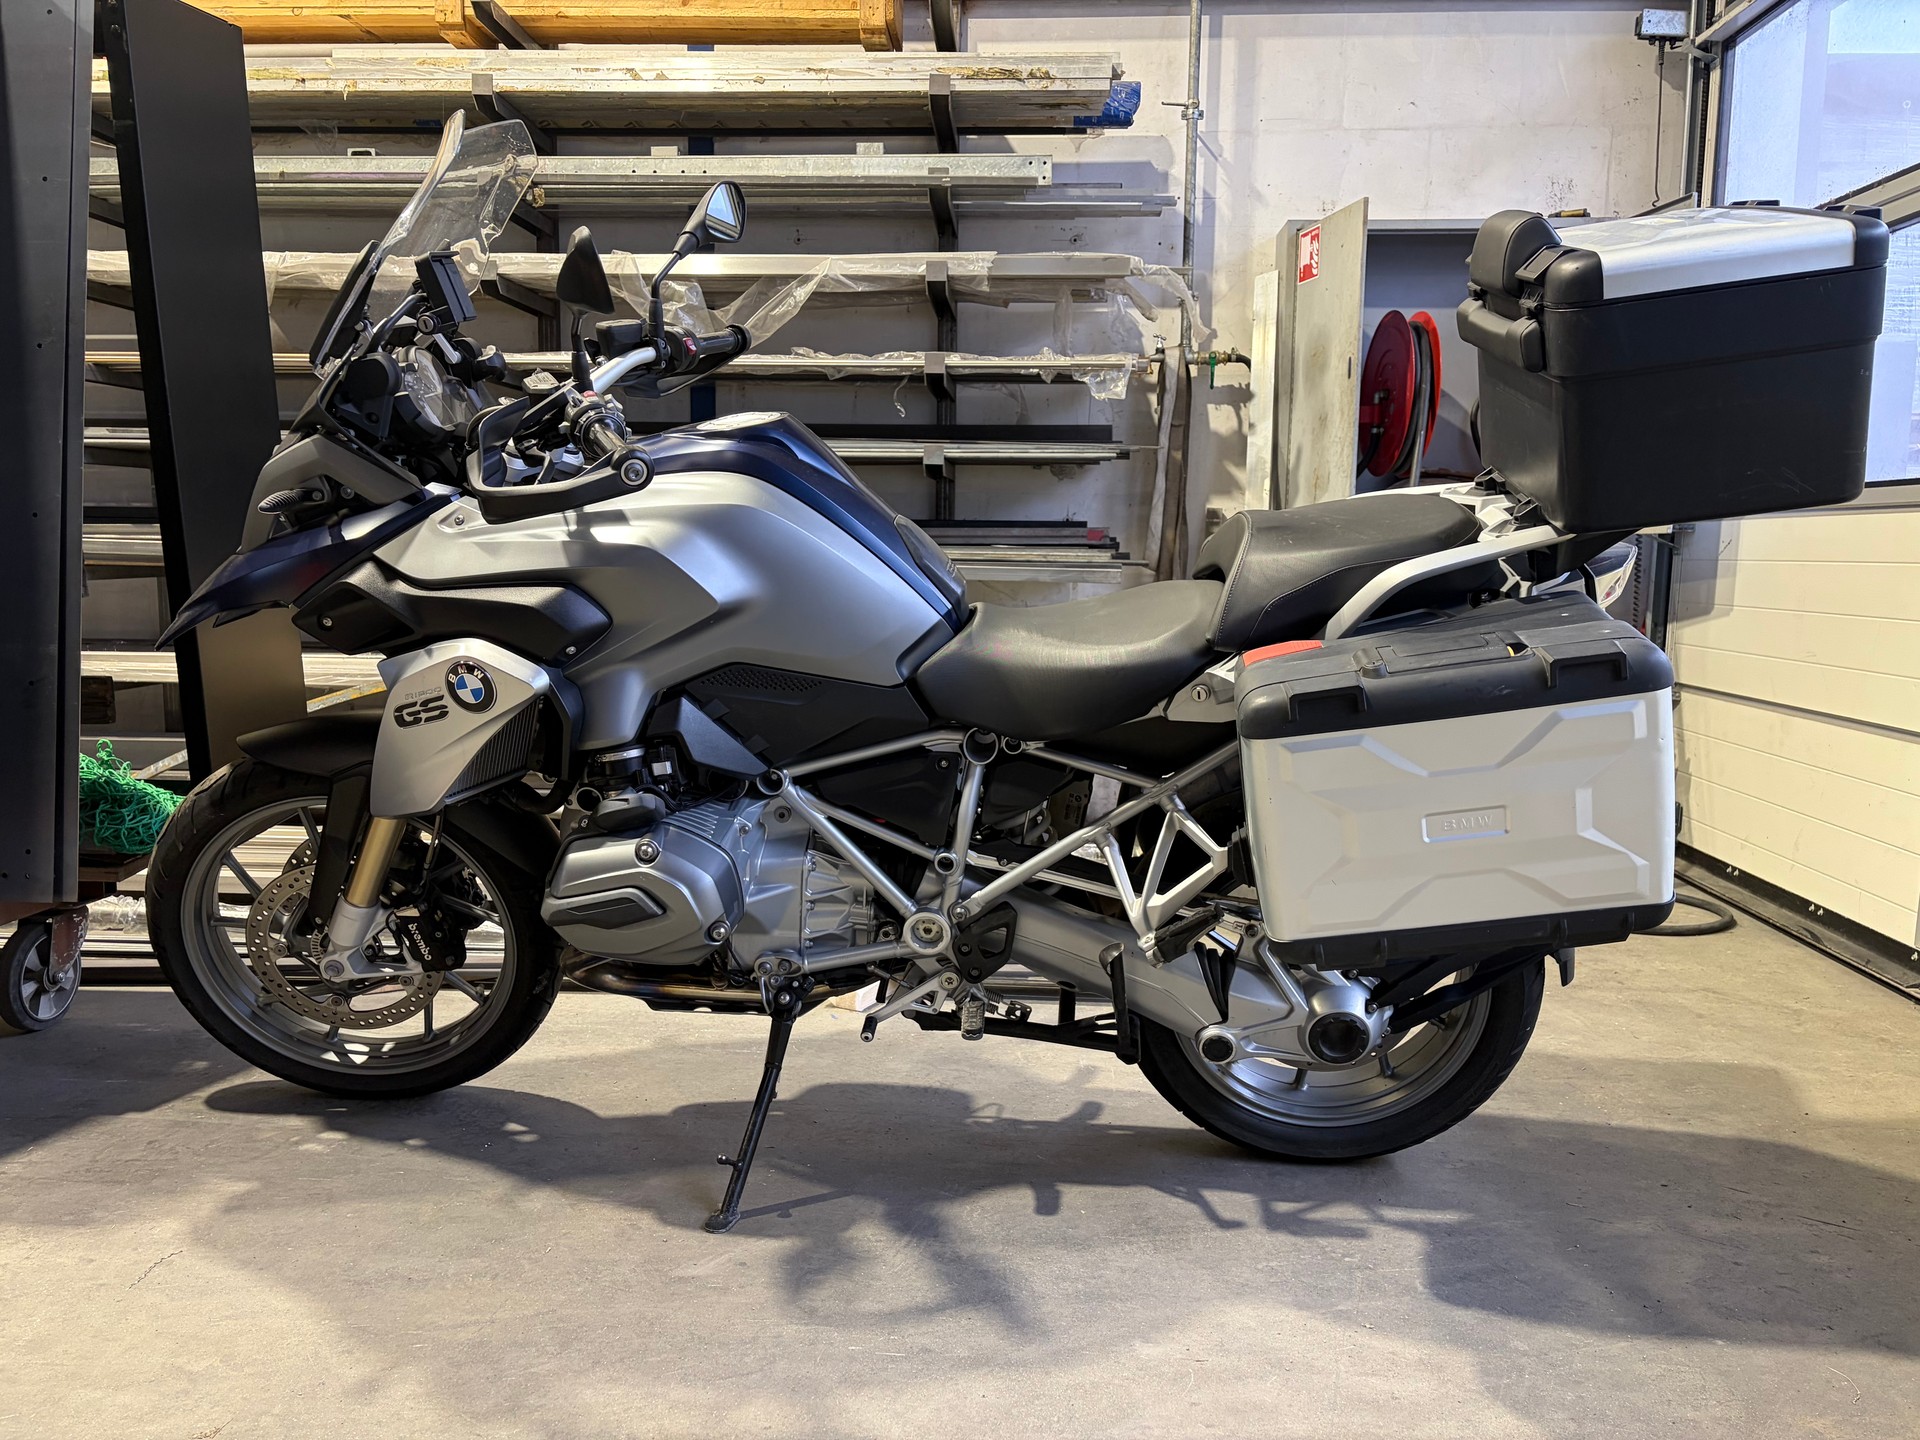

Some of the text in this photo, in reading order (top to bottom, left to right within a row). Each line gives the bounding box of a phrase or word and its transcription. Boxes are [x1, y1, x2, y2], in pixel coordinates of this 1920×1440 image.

[448, 664, 485, 684] BMW
[393, 695, 449, 729] GS
[1444, 815, 1493, 831] BMW
[408, 923, 432, 961] brembo
